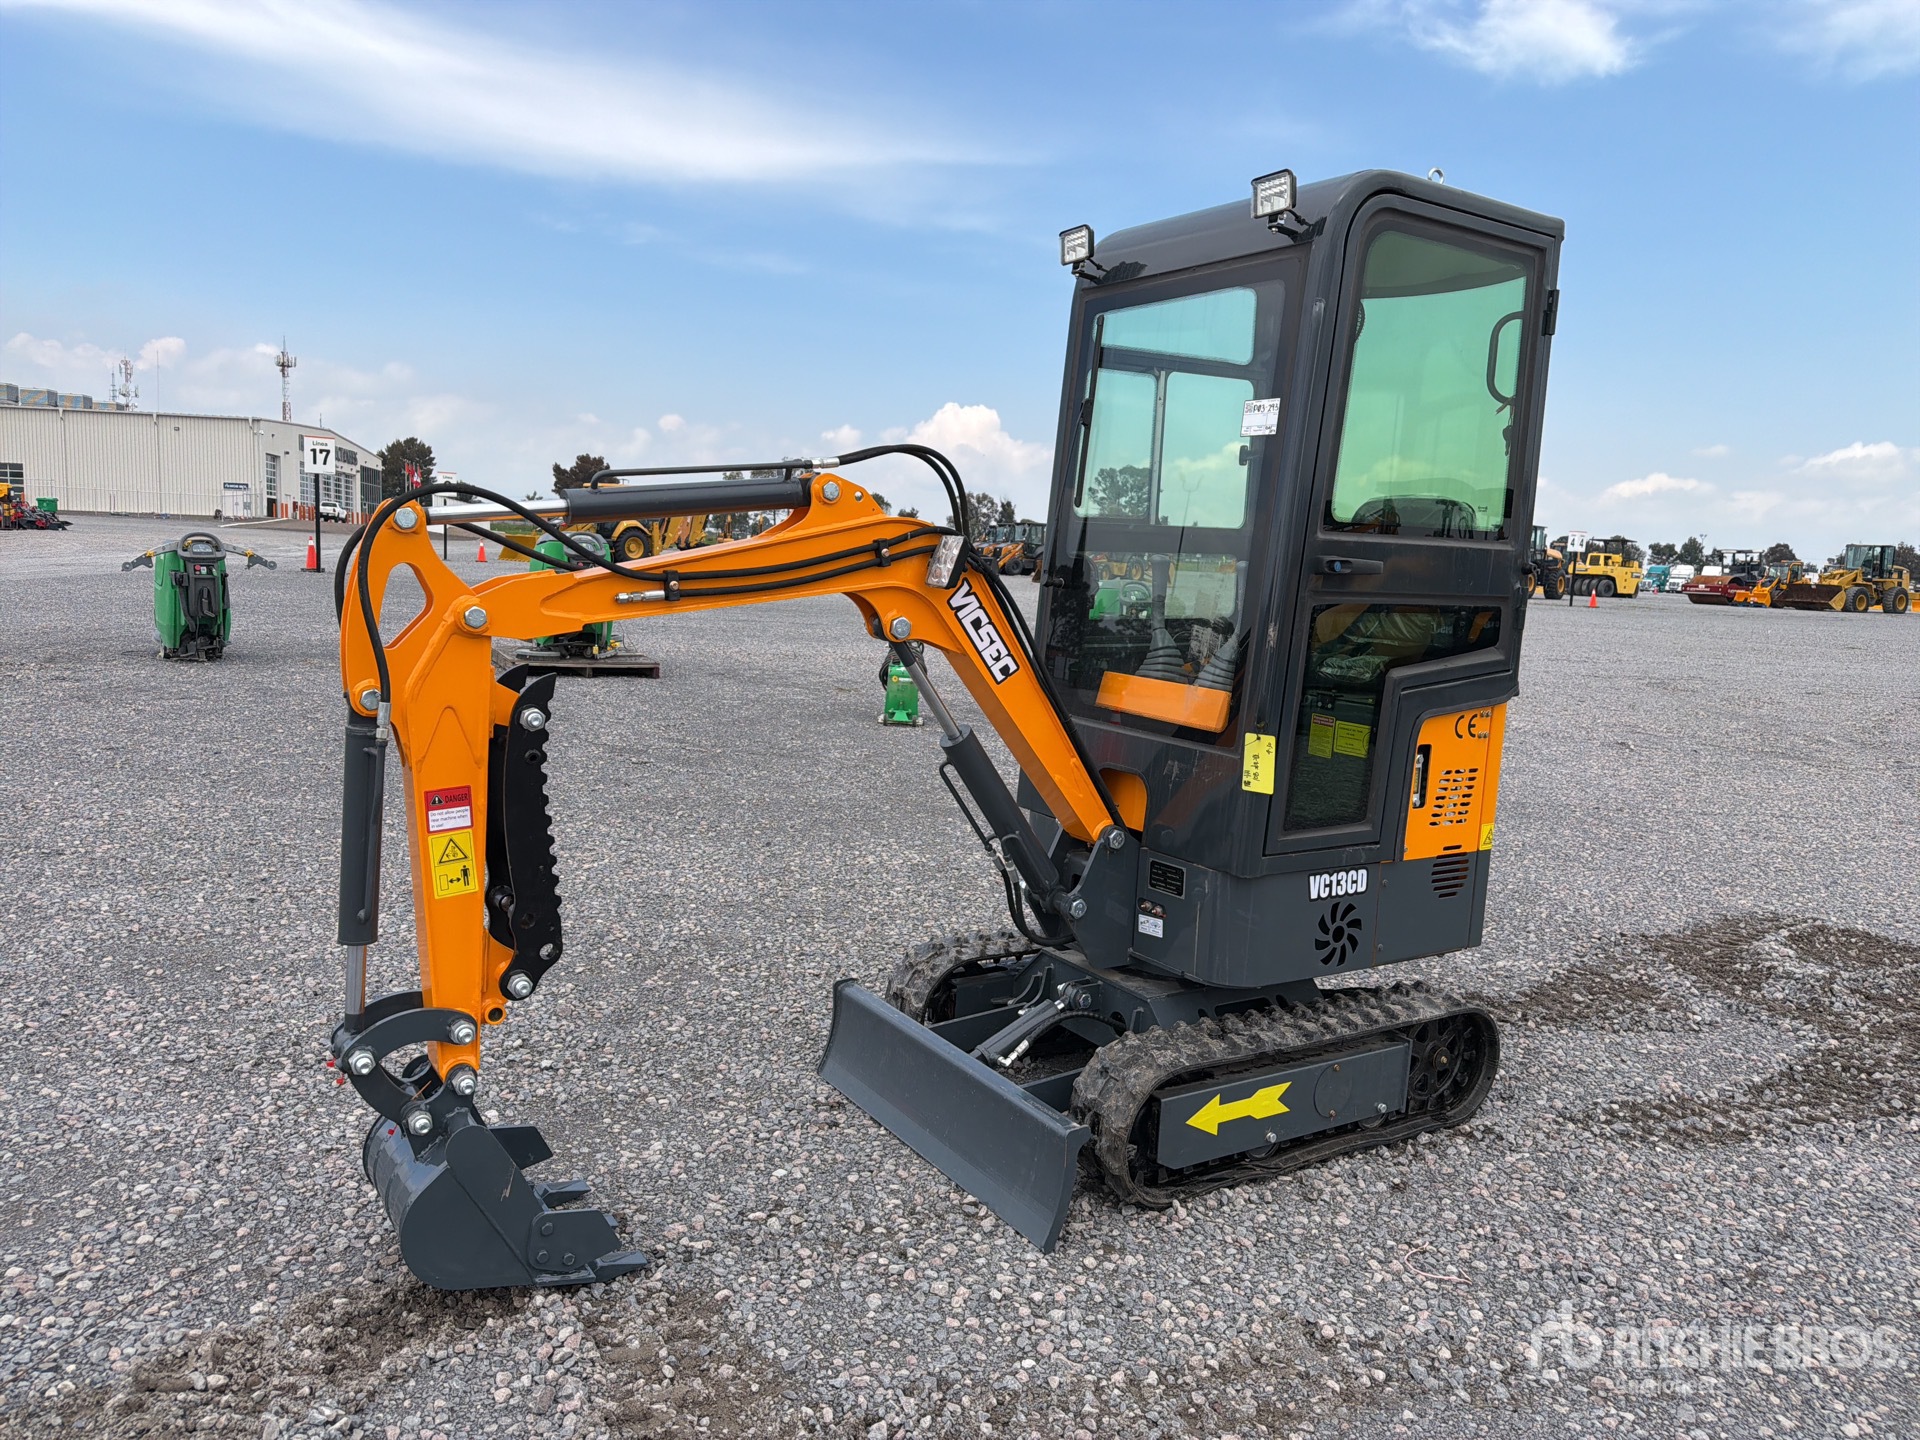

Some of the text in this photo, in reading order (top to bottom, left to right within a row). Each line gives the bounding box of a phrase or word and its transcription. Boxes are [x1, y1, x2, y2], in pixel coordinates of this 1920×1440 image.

[310, 448, 331, 465] 17
[948, 578, 1020, 684] VICSEC
[445, 793, 469, 803] DANGER
[1309, 868, 1368, 900] VC13CD
